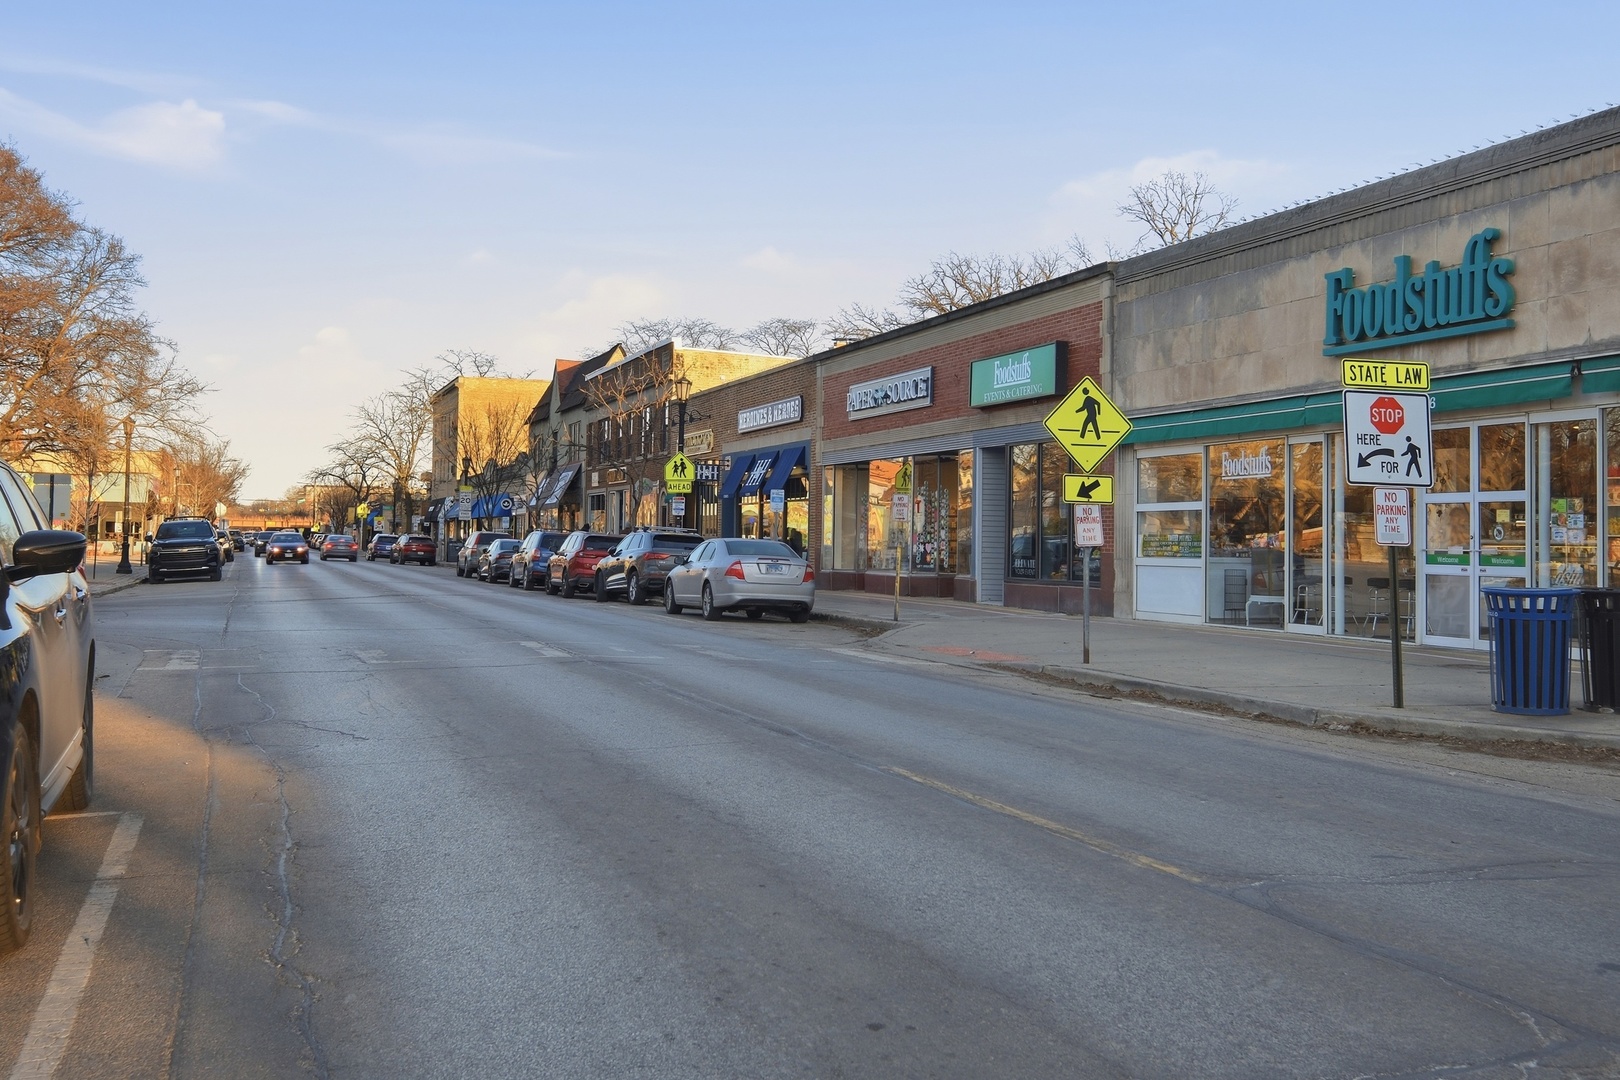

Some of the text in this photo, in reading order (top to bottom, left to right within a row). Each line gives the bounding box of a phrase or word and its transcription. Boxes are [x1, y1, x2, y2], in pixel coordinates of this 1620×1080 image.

[1323, 227, 1515, 346] Foodstuffs
[994, 352, 1031, 385] Foodstuffs
[1349, 364, 1422, 384] STATE LAW
[846, 376, 926, 412] PAPER SOURCE
[984, 383, 1043, 402] EVENTS & CATERING
[740, 400, 799, 429] HEROINES & HEROES
[1371, 407, 1403, 423] STOP
[1356, 433, 1381, 446] HERE
[1222, 445, 1272, 477] Foodstuffs
[1381, 461, 1399, 473] FOR
[667, 483, 691, 491] AHEAD
[1384, 492, 1398, 503] NO
[1082, 507, 1093, 516] NO
[1376, 504, 1407, 516] PARKING
[1076, 516, 1100, 525] PARKING
[1385, 516, 1399, 525] ANY
[1384, 525, 1400, 533] TIME
